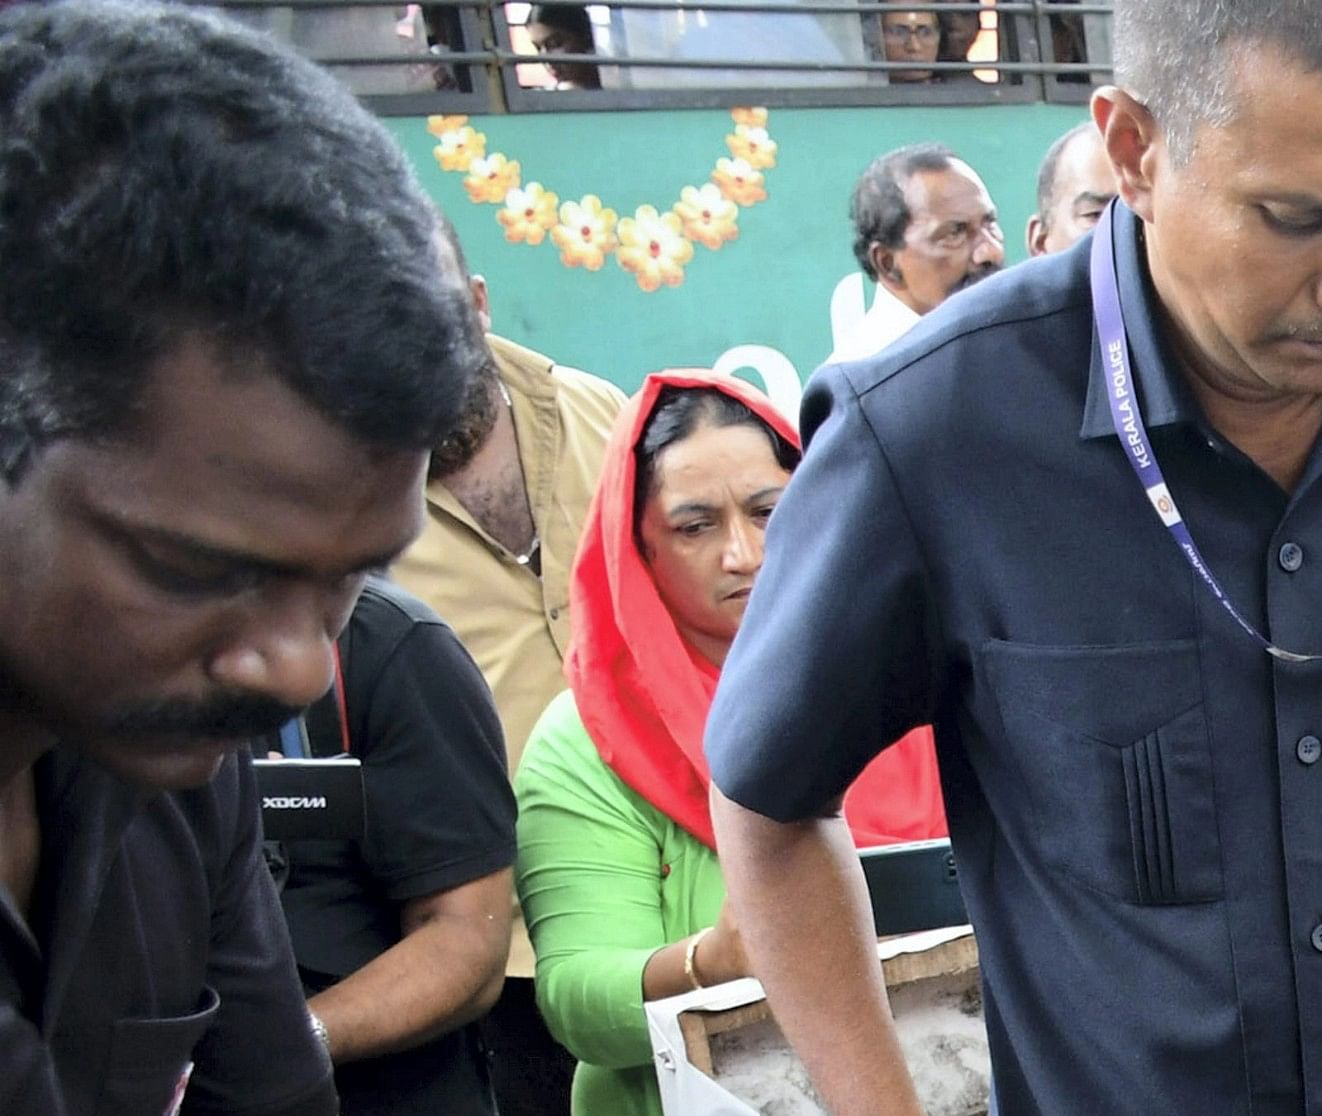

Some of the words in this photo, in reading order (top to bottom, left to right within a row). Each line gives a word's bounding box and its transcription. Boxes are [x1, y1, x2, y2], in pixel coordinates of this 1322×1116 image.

[1108, 339, 1129, 399] POLICE
[1117, 399, 1151, 469] KERALA
[262, 796, 328, 809] XDCAM
